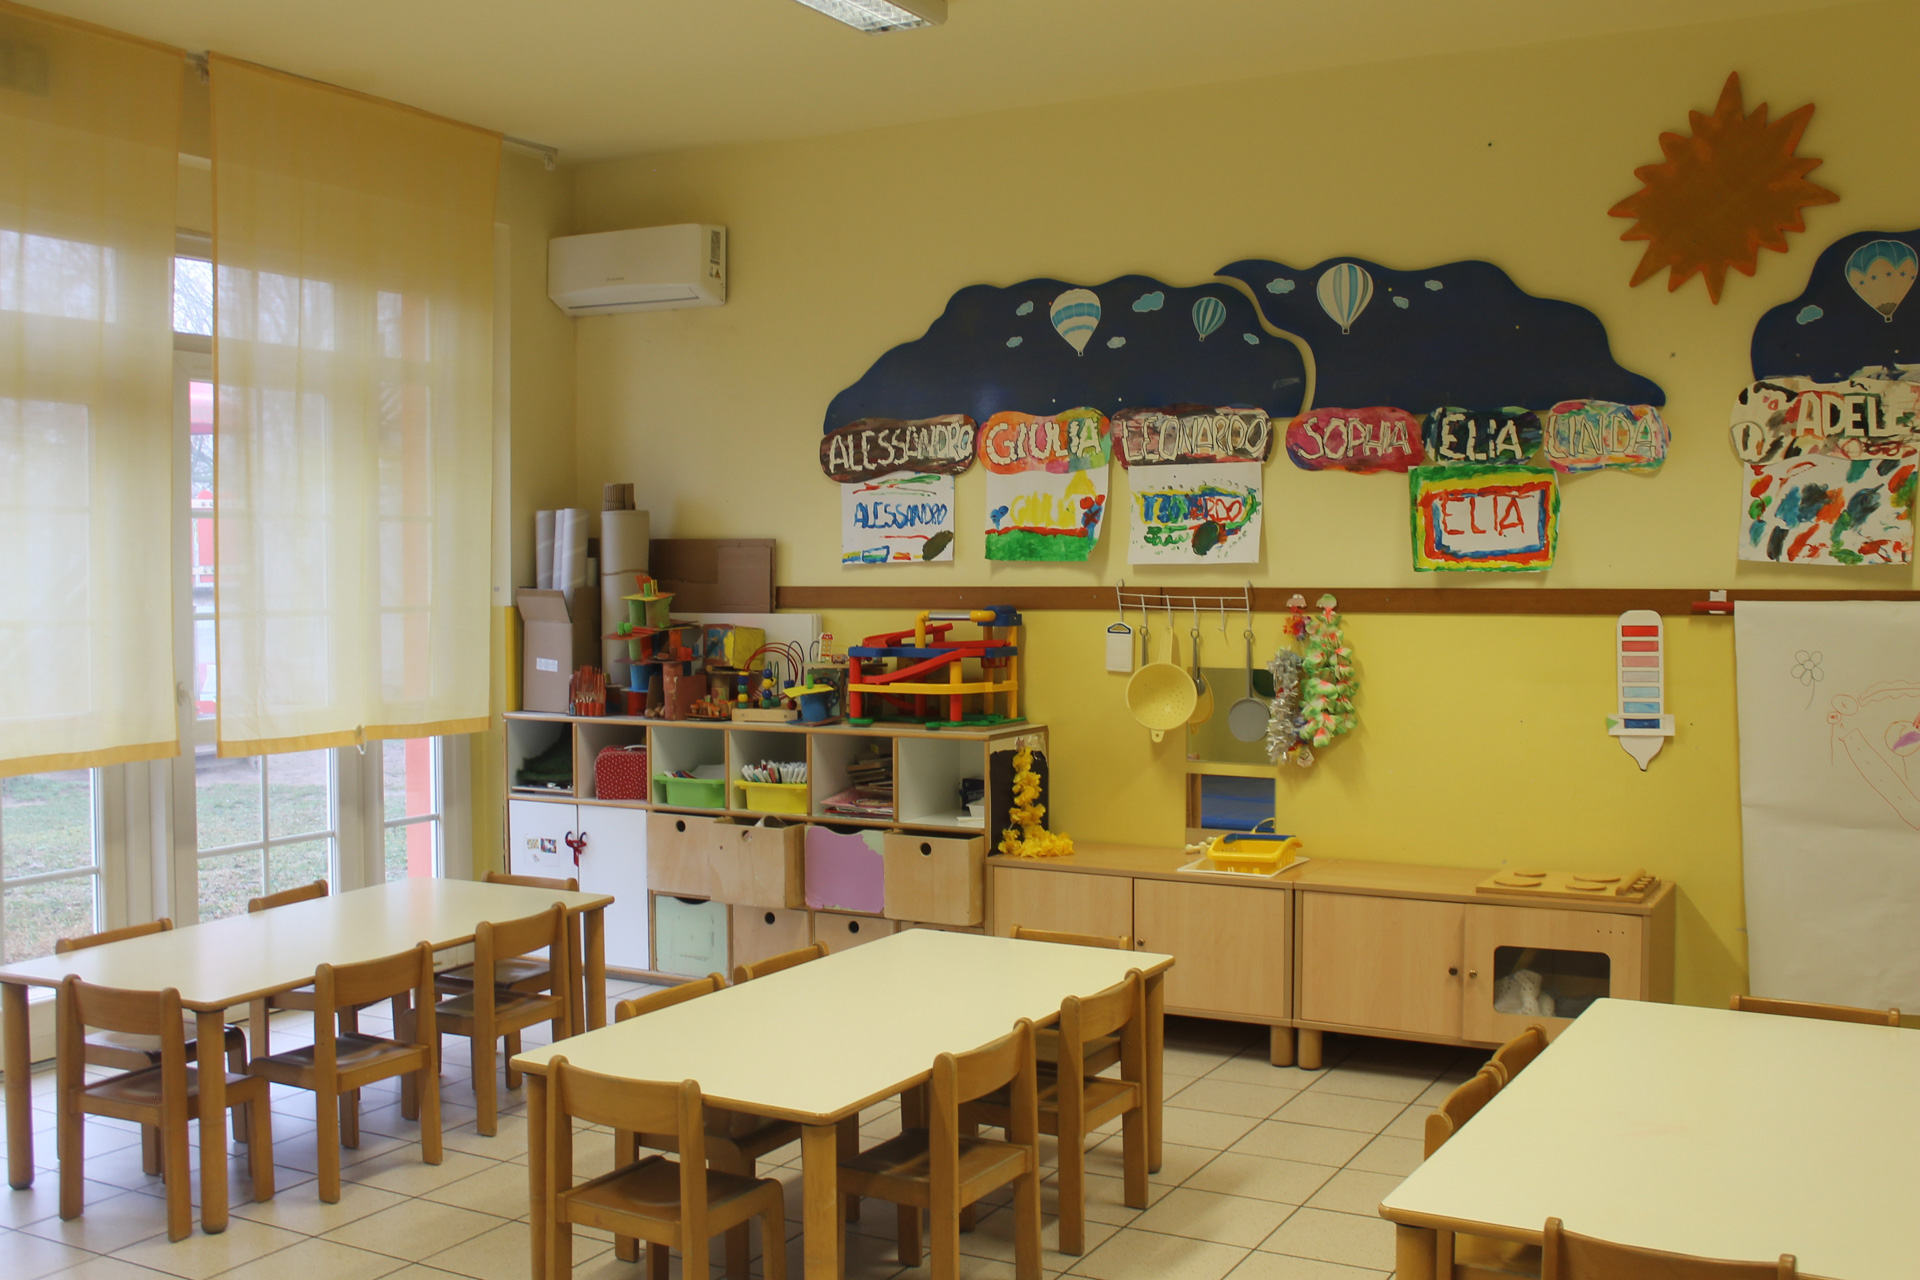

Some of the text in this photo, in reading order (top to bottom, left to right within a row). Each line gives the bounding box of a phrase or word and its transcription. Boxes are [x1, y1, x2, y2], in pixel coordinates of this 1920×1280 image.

[829, 422, 975, 473] ALESSANDRO
[986, 420, 1102, 465] GIULIA
[1122, 414, 1268, 462] LEONARDO
[1440, 412, 1523, 461] ELIA
[1547, 414, 1657, 459] LINDA
[854, 501, 948, 529] ALESSANDRO
